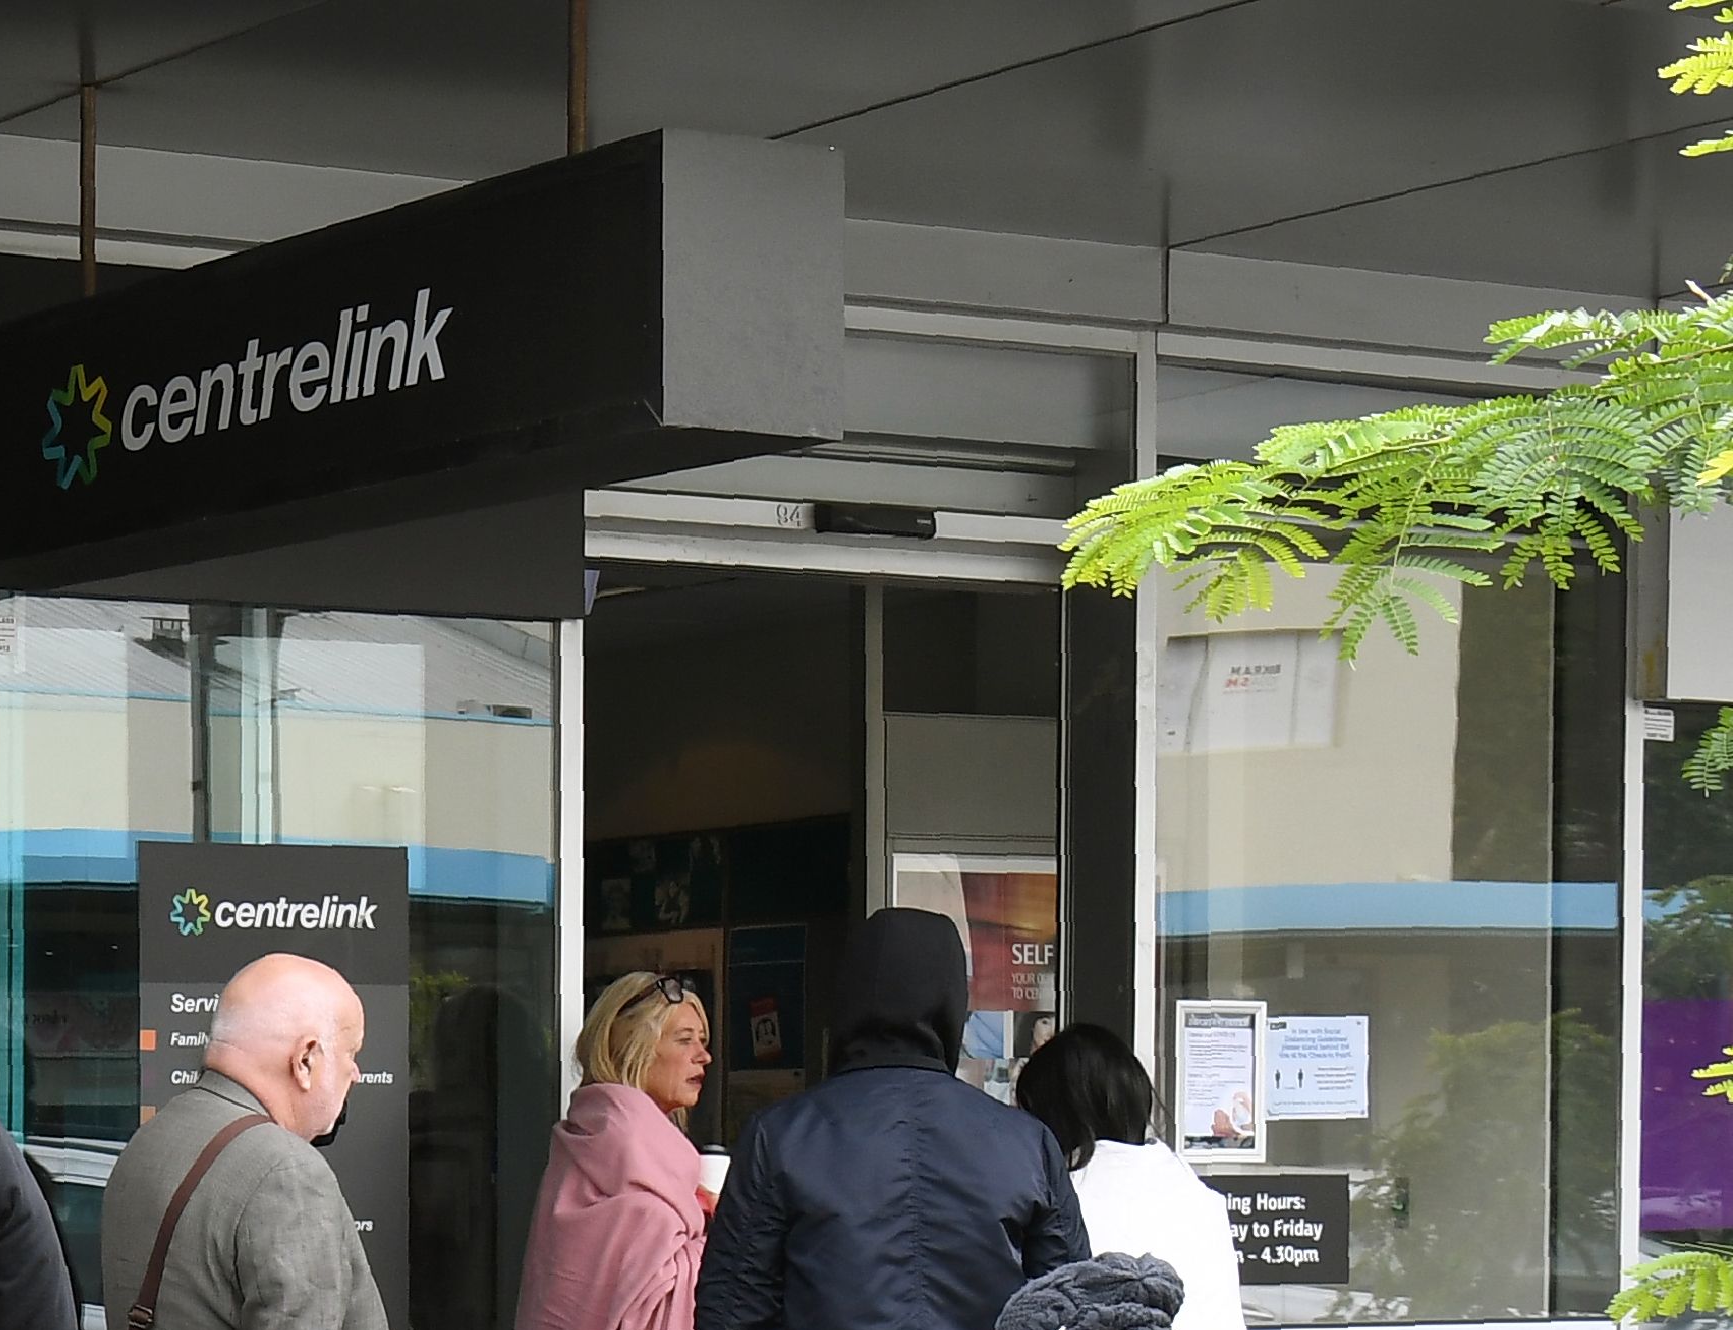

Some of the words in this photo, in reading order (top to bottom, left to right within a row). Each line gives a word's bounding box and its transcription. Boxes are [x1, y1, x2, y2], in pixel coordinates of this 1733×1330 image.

[121, 288, 453, 451] centrelink
[214, 895, 378, 929] centrelink
[1011, 943, 1054, 965] SELF
[170, 993, 220, 1013] Servi
[358, 1072, 393, 1084] rents
[1256, 1192, 1306, 1211] Hours:
[1252, 1222, 1270, 1237] to
[1273, 1219, 1323, 1241] Friday
[1260, 1246, 1320, 1267] 4.30pm
